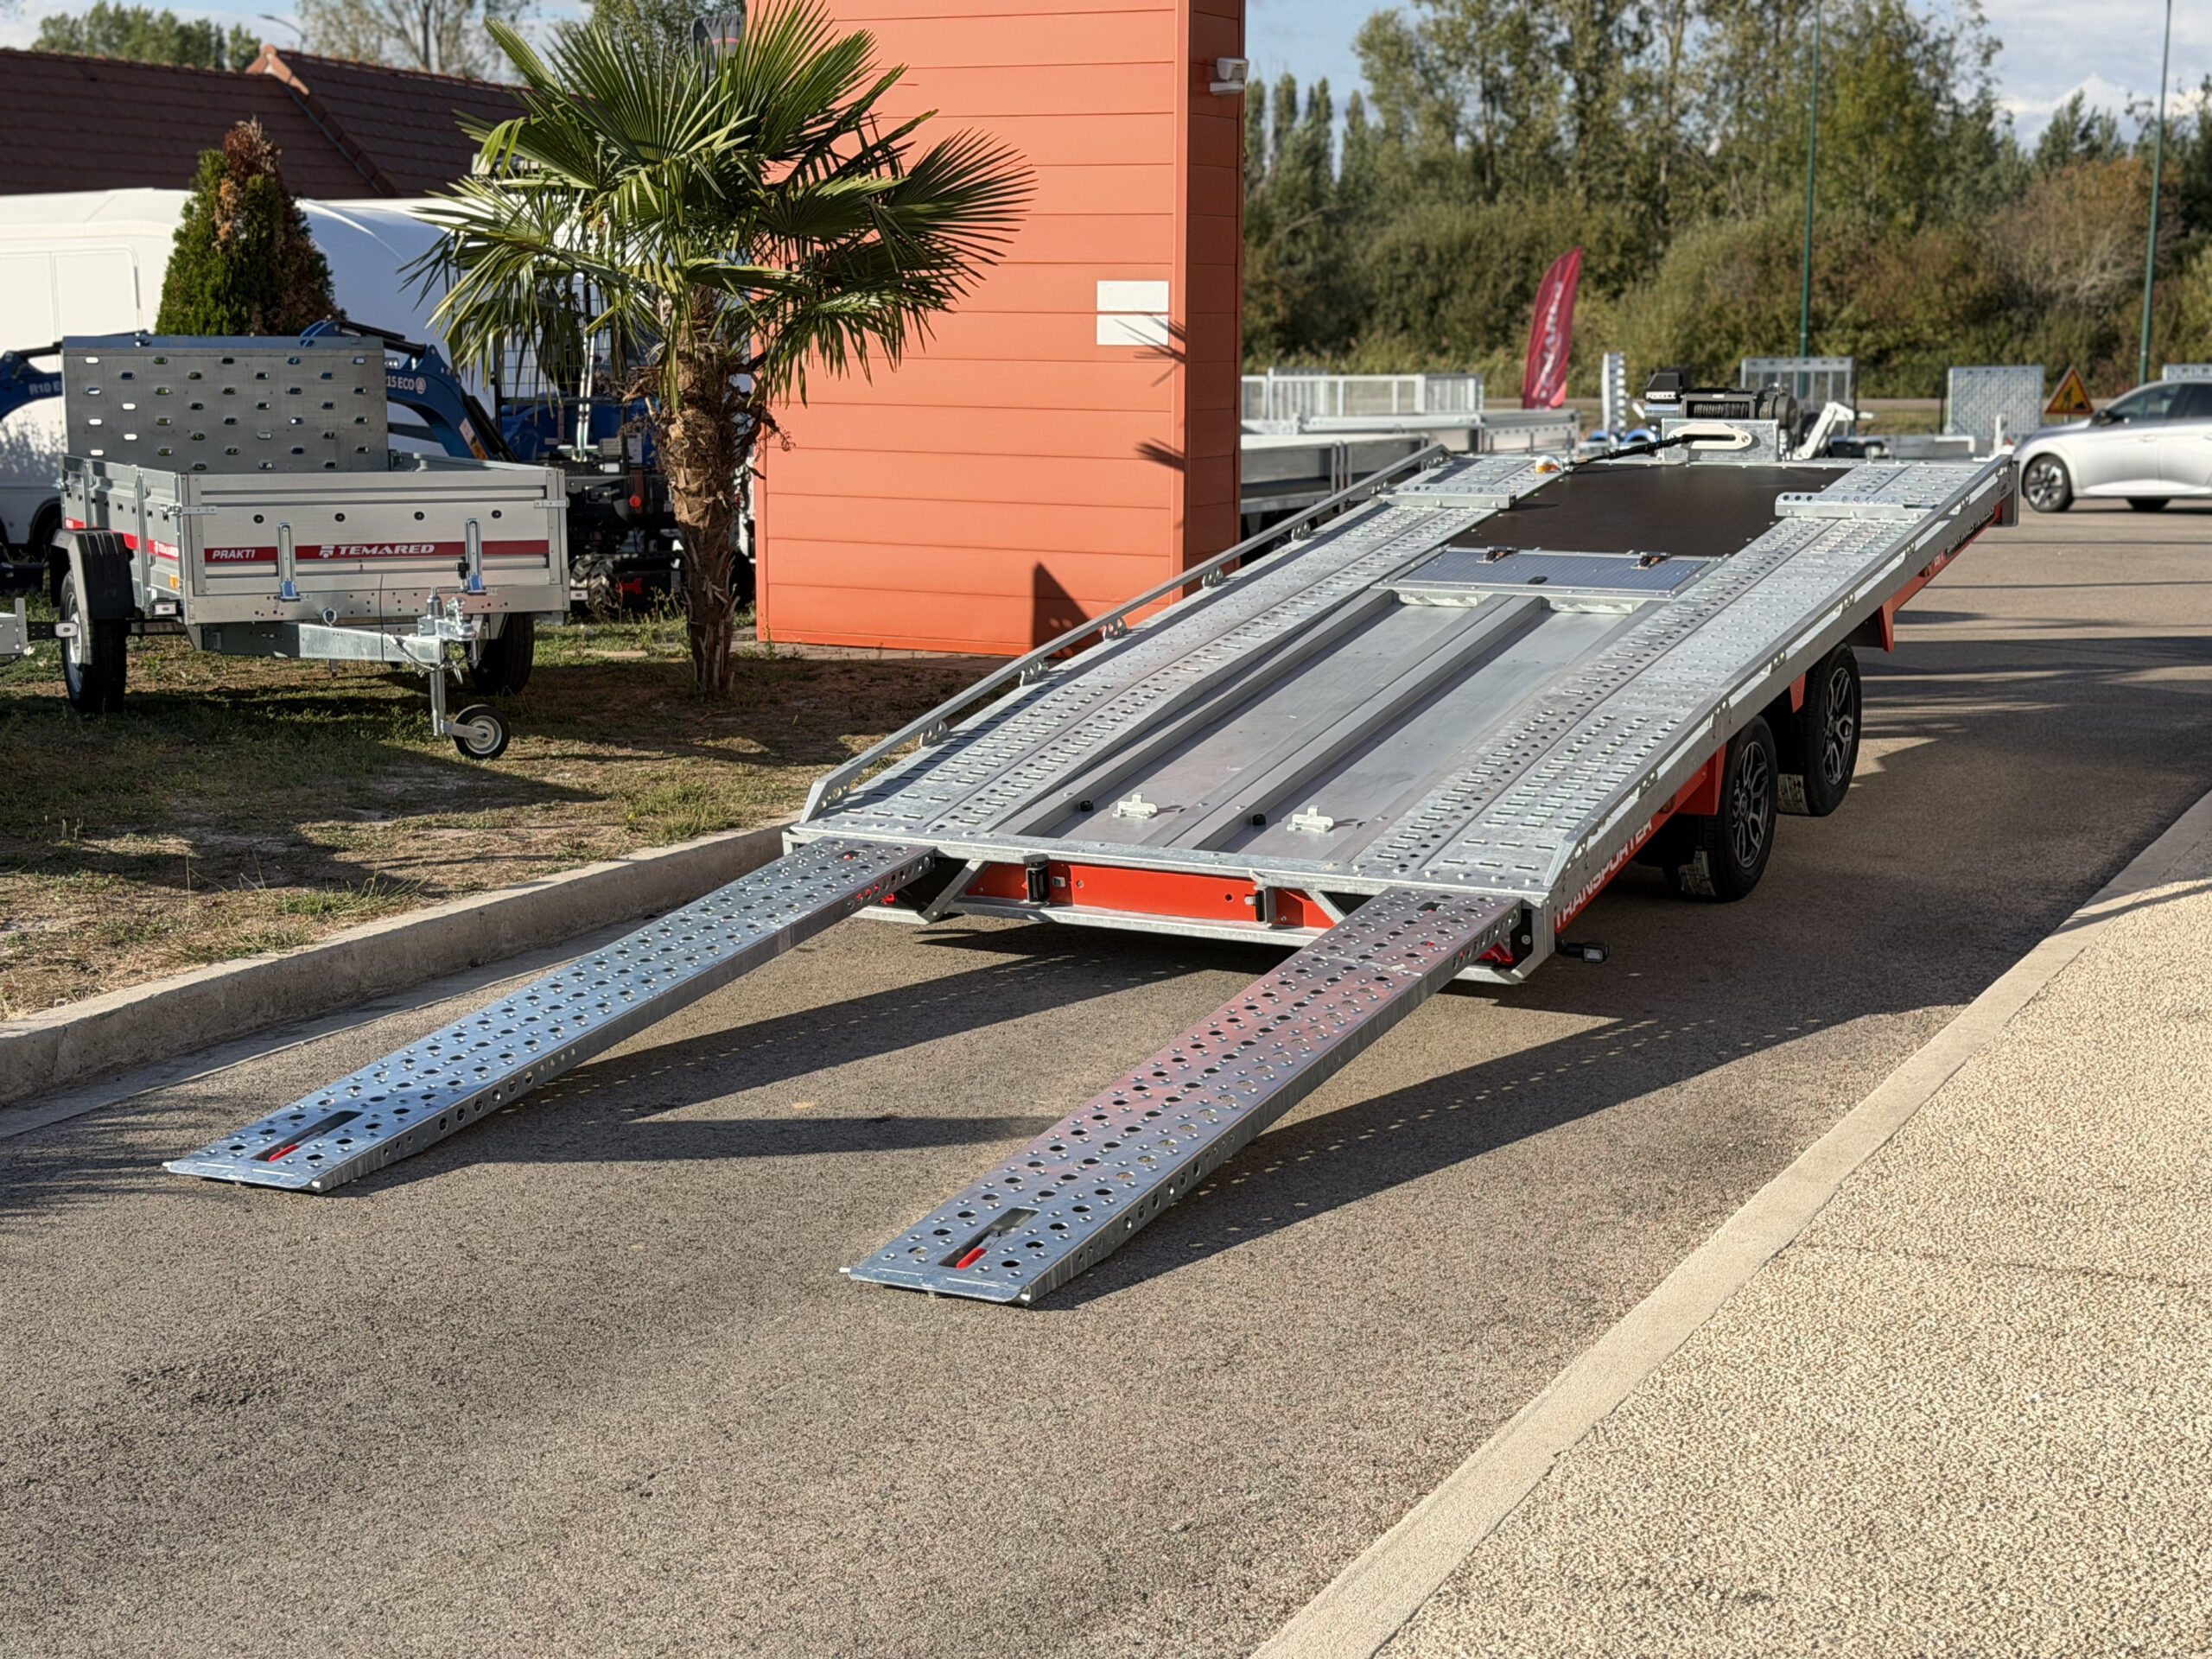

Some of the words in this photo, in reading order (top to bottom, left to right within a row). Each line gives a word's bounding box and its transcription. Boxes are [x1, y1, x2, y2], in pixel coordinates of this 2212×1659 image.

[386, 375, 397, 388] 15
[397, 377, 415, 391] ECO
[213, 549, 256, 560] PRAKTI
[338, 543, 435, 556] TEMARED
